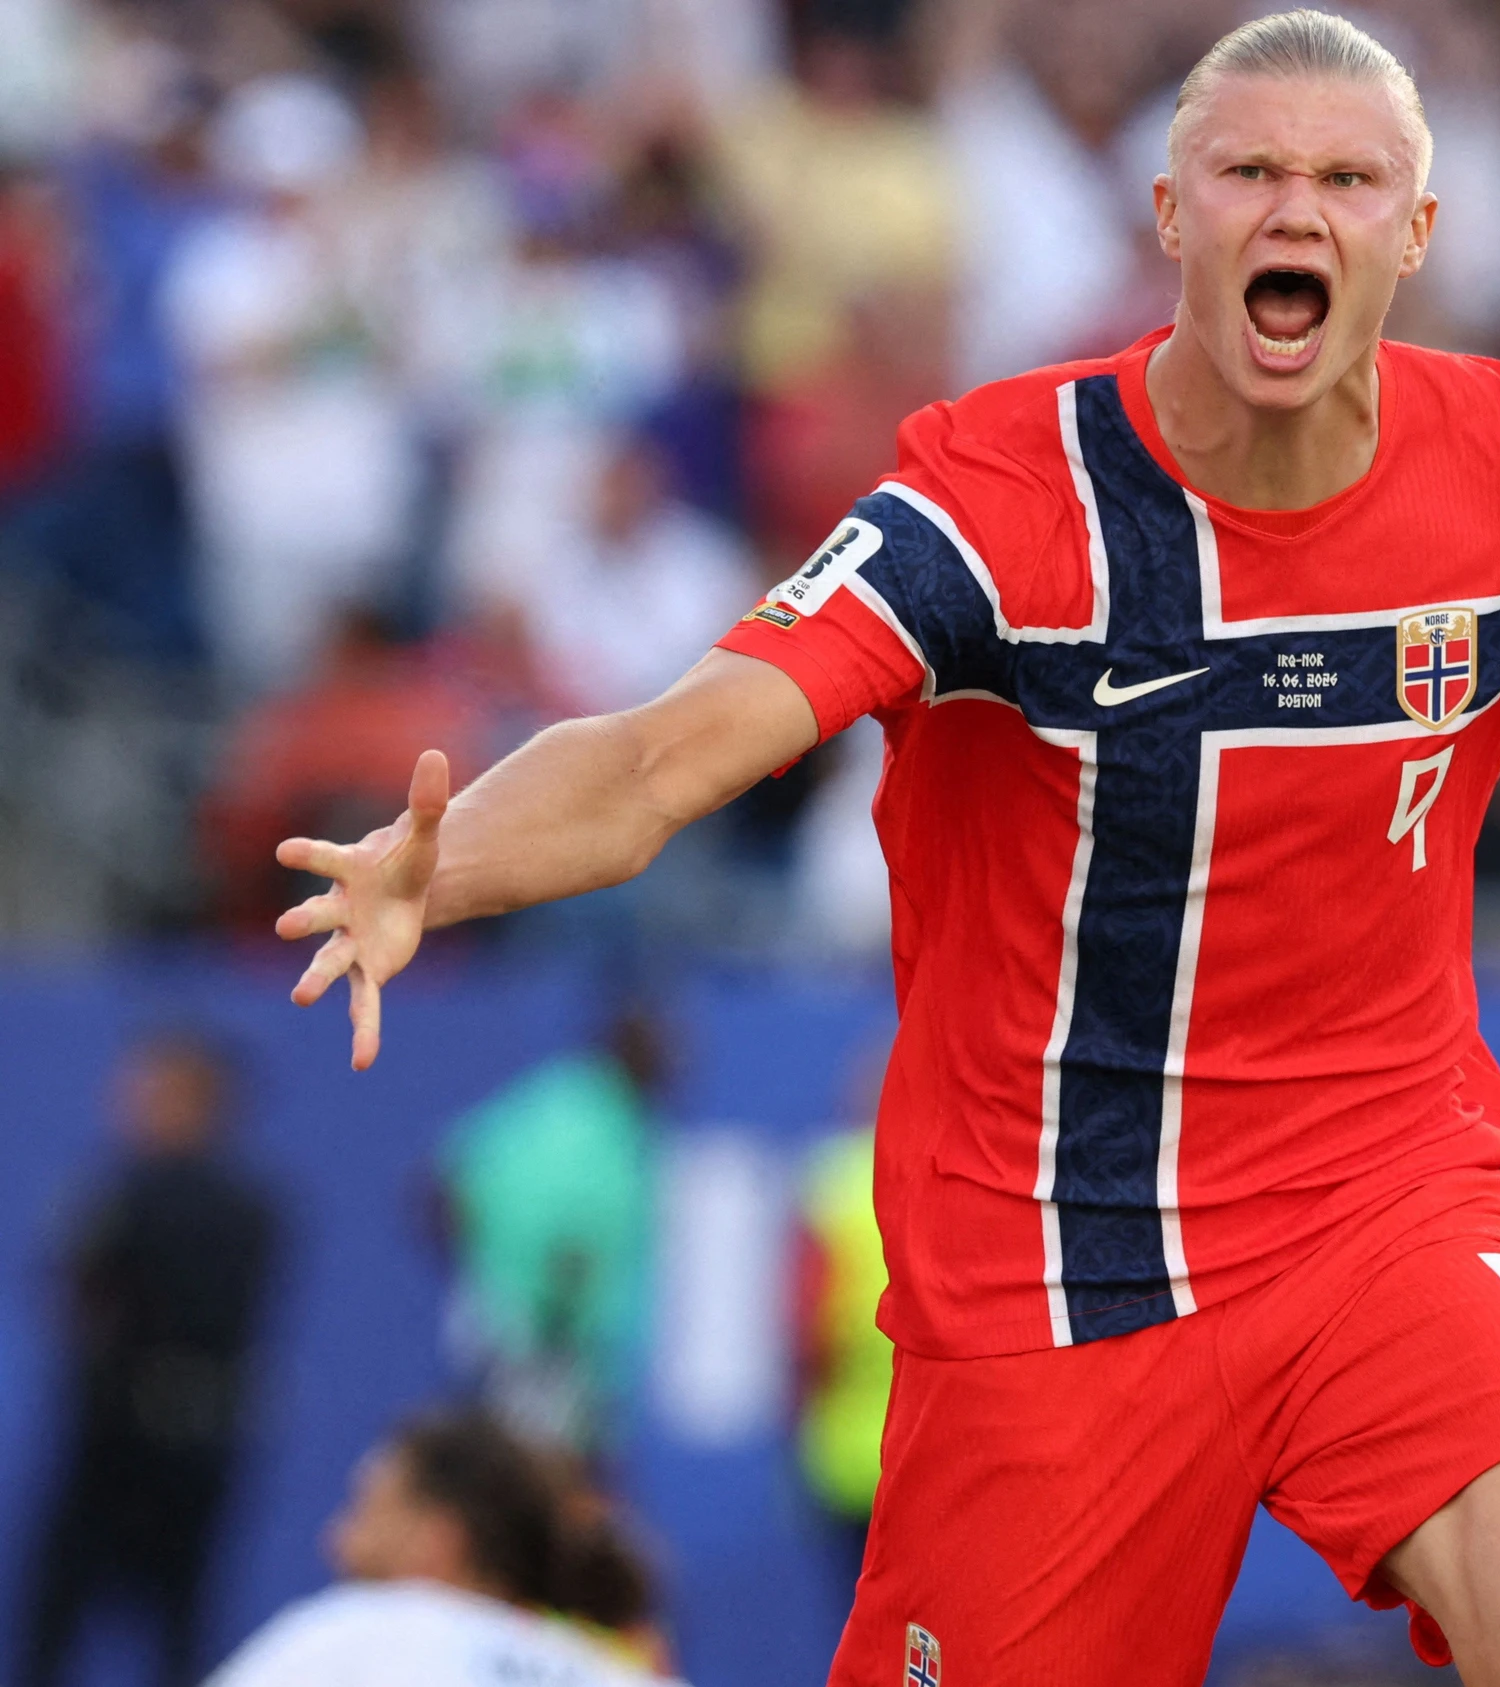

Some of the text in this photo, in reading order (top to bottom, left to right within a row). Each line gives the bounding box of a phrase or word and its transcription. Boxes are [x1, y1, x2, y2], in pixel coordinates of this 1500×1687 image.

[764, 608, 795, 621] DEBUT
[1425, 613, 1449, 626] NORGE
[1277, 653, 1324, 667] IRQ-NOR
[1278, 694, 1321, 708] BOSTON
[1387, 743, 1455, 873] 9
